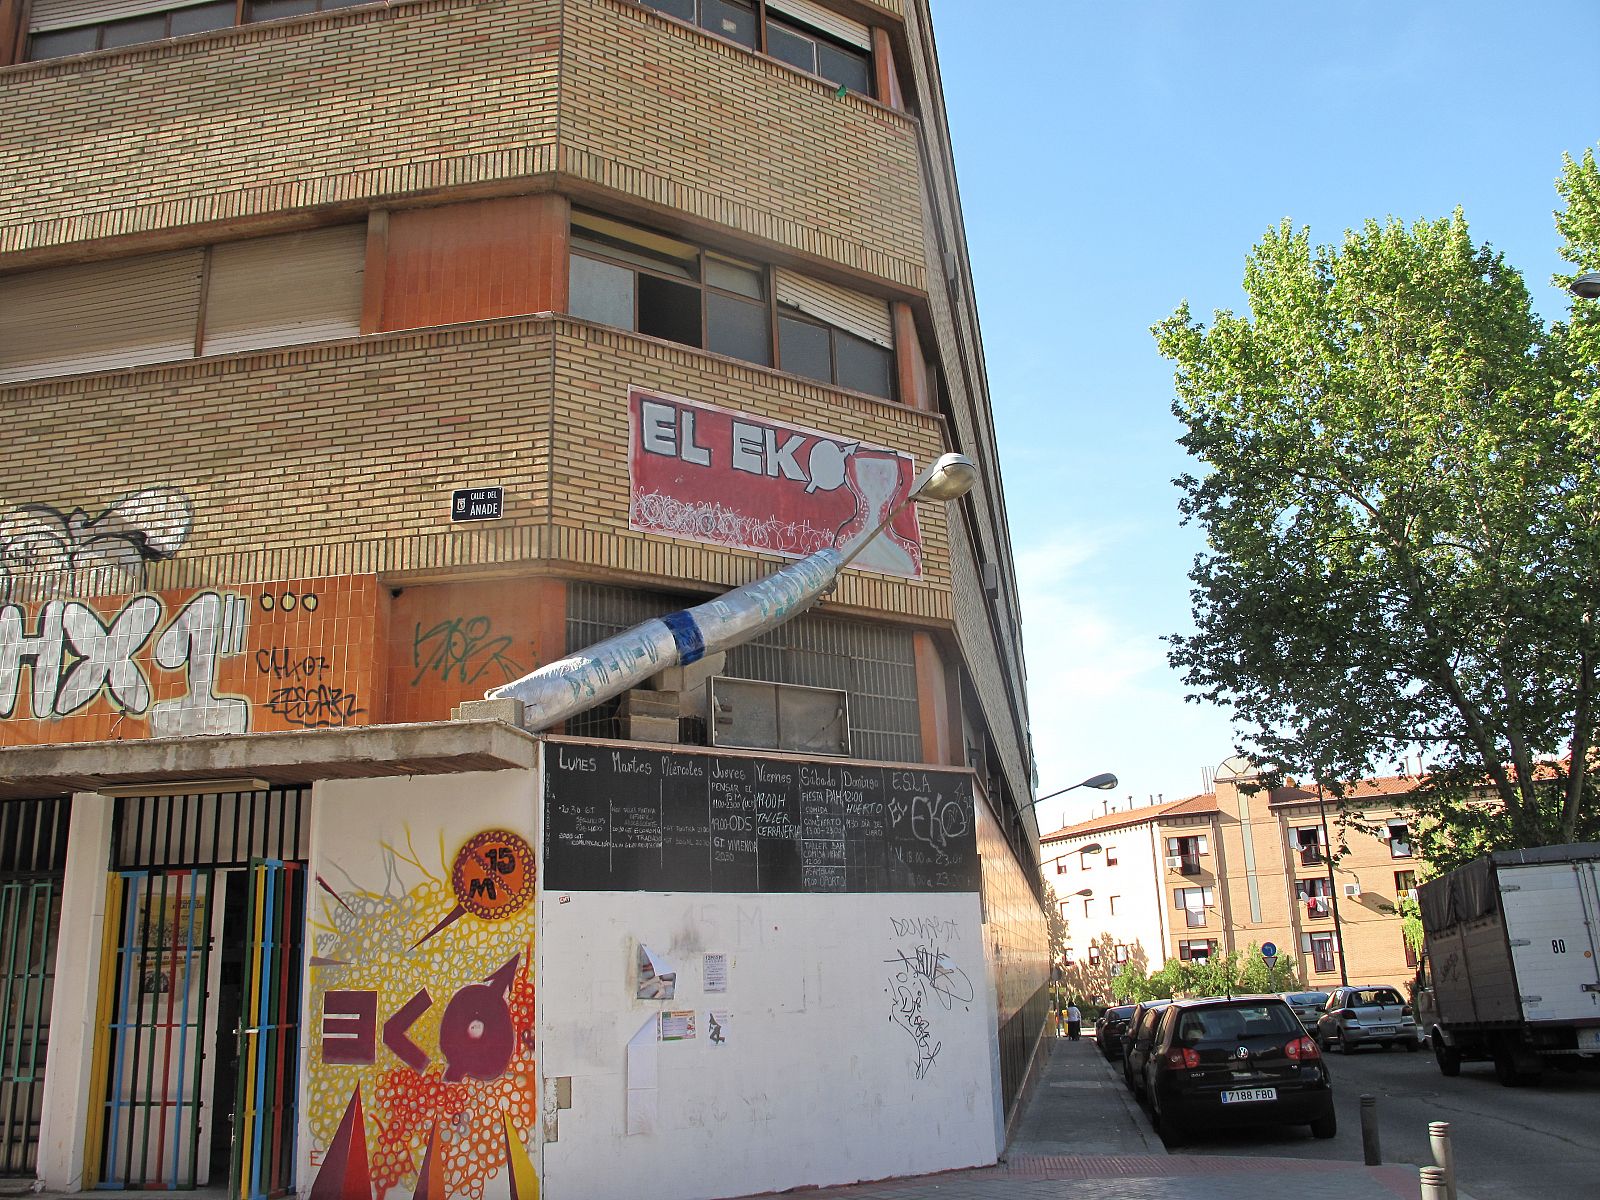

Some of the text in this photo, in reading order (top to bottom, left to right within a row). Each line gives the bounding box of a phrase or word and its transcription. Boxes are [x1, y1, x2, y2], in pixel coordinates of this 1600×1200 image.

[640, 400, 712, 467] EL
[470, 492, 485, 500] CALLE
[470, 502, 498, 516] ÁNADE
[612, 751, 652, 773] Martes
[661, 756, 703, 776] Miércoles
[712, 759, 746, 780] Jueves
[756, 763, 792, 784] Viernes
[801, 767, 836, 787] Sábado
[843, 772, 879, 790] Domingo
[711, 783, 739, 793] PENSAR
[757, 812, 791, 824] TALLER
[846, 803, 883, 814] HUERTO
[483, 847, 516, 876] 15
[469, 878, 497, 900] M
[1552, 939, 1566, 954] 80
[1228, 1089, 1273, 1101] 7188 FBD
